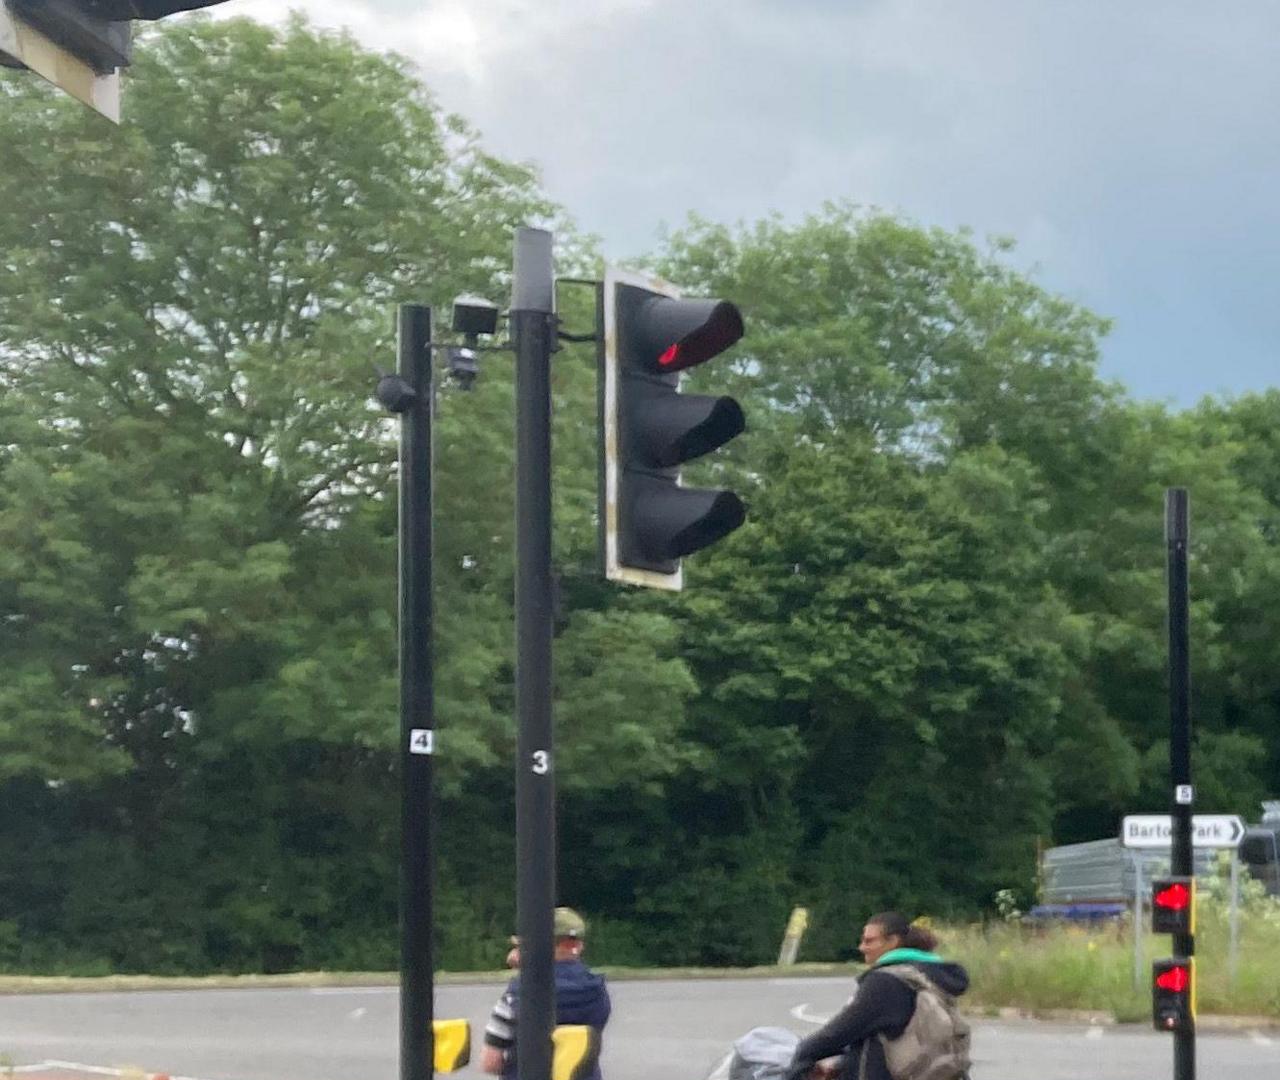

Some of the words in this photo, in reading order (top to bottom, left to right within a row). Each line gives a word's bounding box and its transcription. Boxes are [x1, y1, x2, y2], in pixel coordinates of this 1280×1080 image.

[414, 733, 428, 748] 4
[532, 749, 548, 775] 3
[1129, 823, 1172, 837] Barto
[1192, 824, 1221, 838] ark
